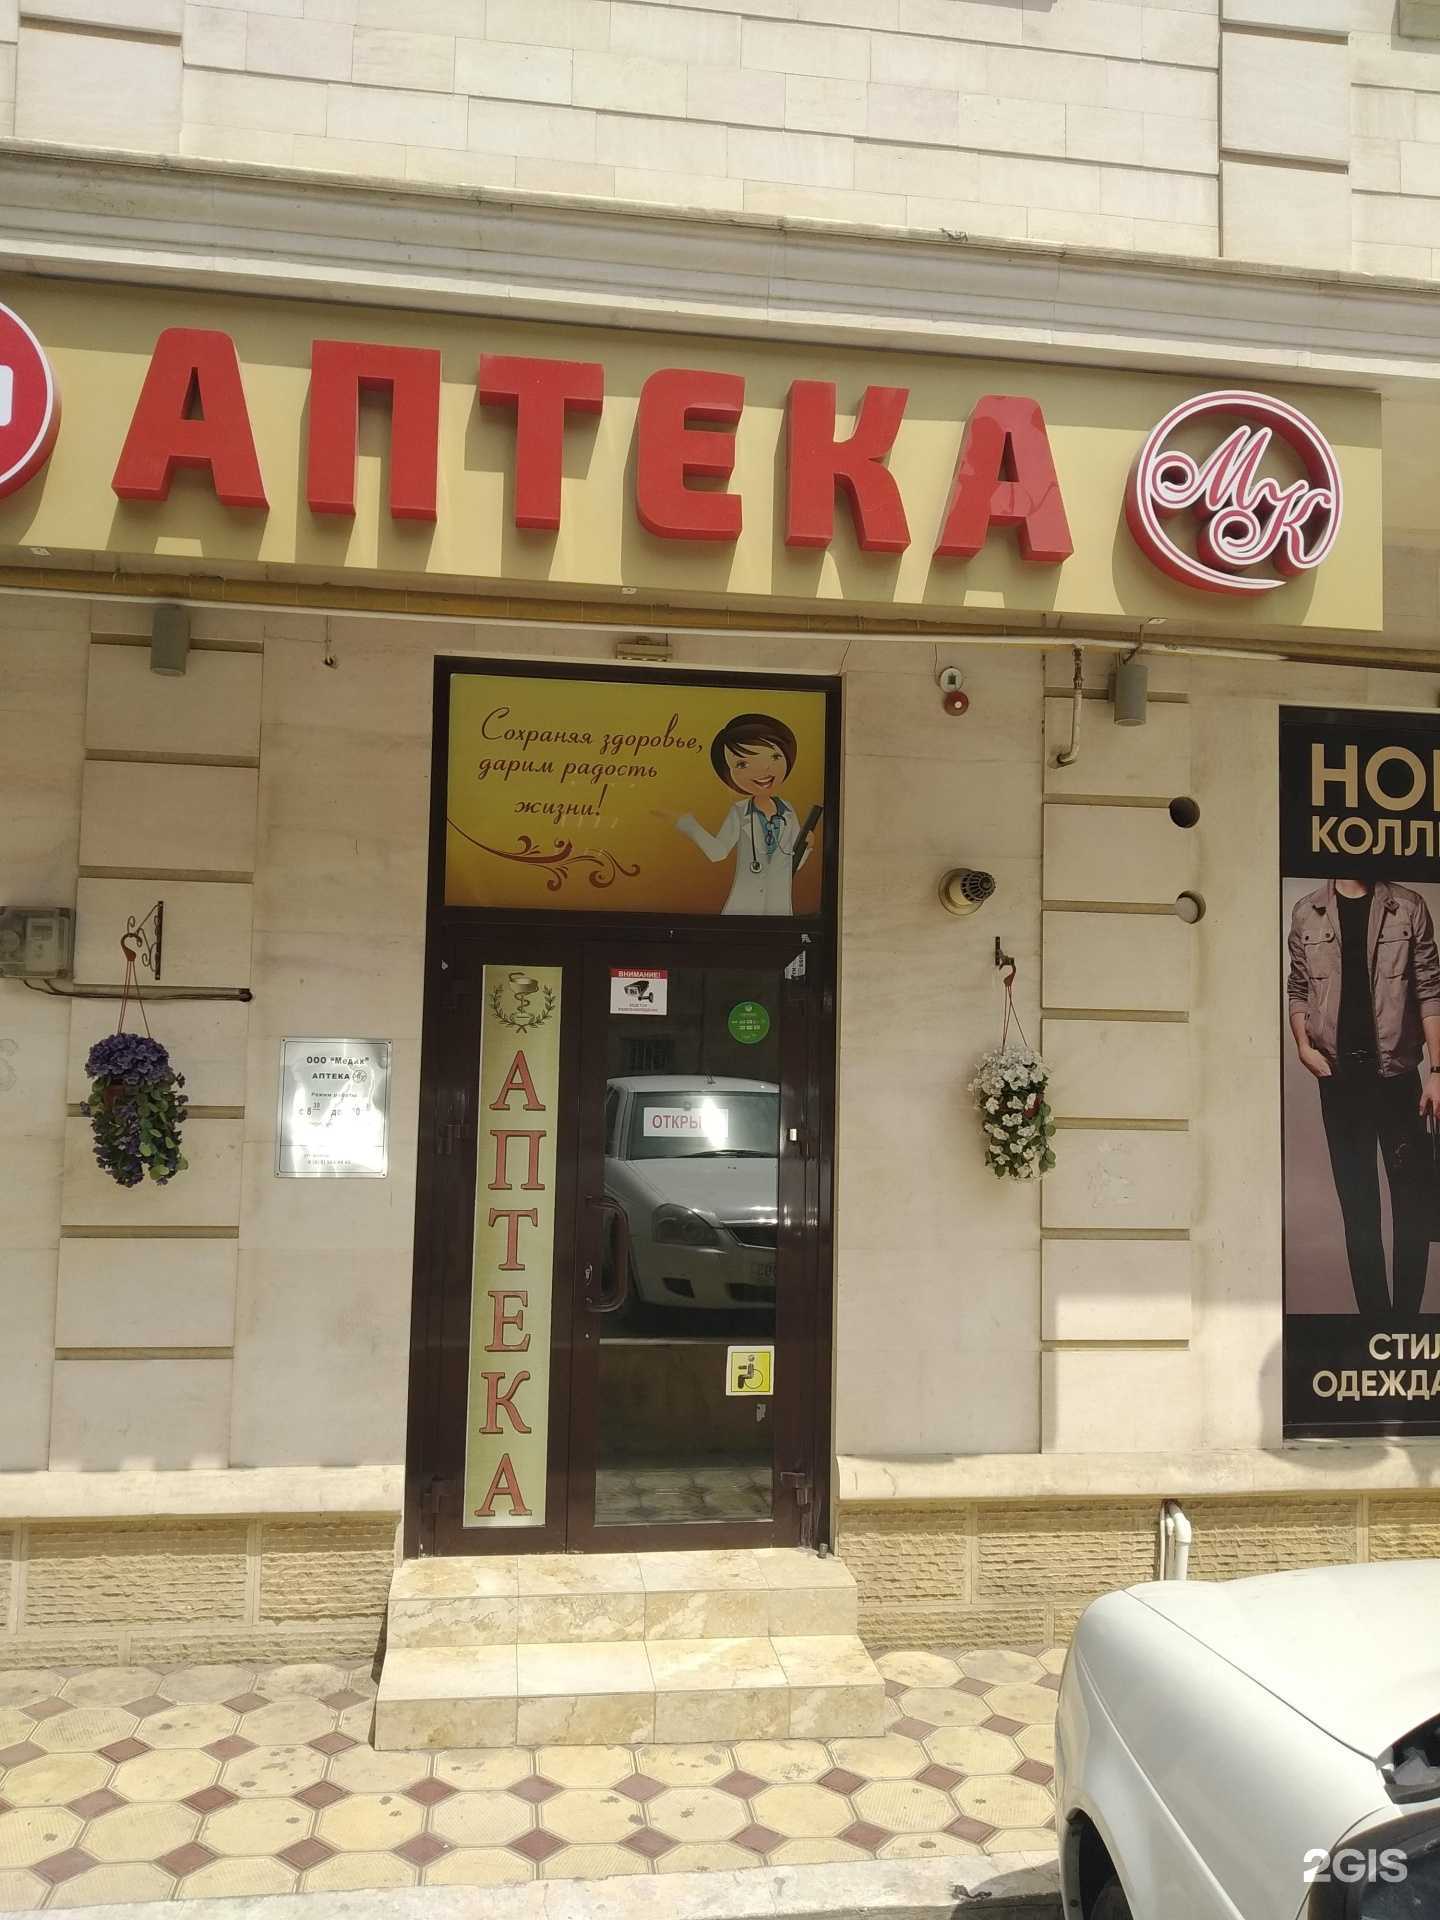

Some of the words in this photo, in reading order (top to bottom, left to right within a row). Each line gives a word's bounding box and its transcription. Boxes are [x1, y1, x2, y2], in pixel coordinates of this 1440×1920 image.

[111, 327, 1075, 565] АПТЕКА
[480, 706, 593, 751] Сохраняя
[599, 711, 703, 756] здоровье,
[478, 757, 554, 781] дарим
[560, 761, 658, 784] радость
[1311, 743, 1440, 811] НО
[513, 783, 608, 824] жизни!
[1311, 815, 1440, 857] КОЛЛ
[618, 970, 661, 978] ВНИМАНИЕ!
[306, 1056, 327, 1064] ООО
[311, 1072, 350, 1080] АПТЕКА
[652, 1114, 715, 1129] ОТКРЫ
[475, 1049, 547, 1518] АПТЕКА
